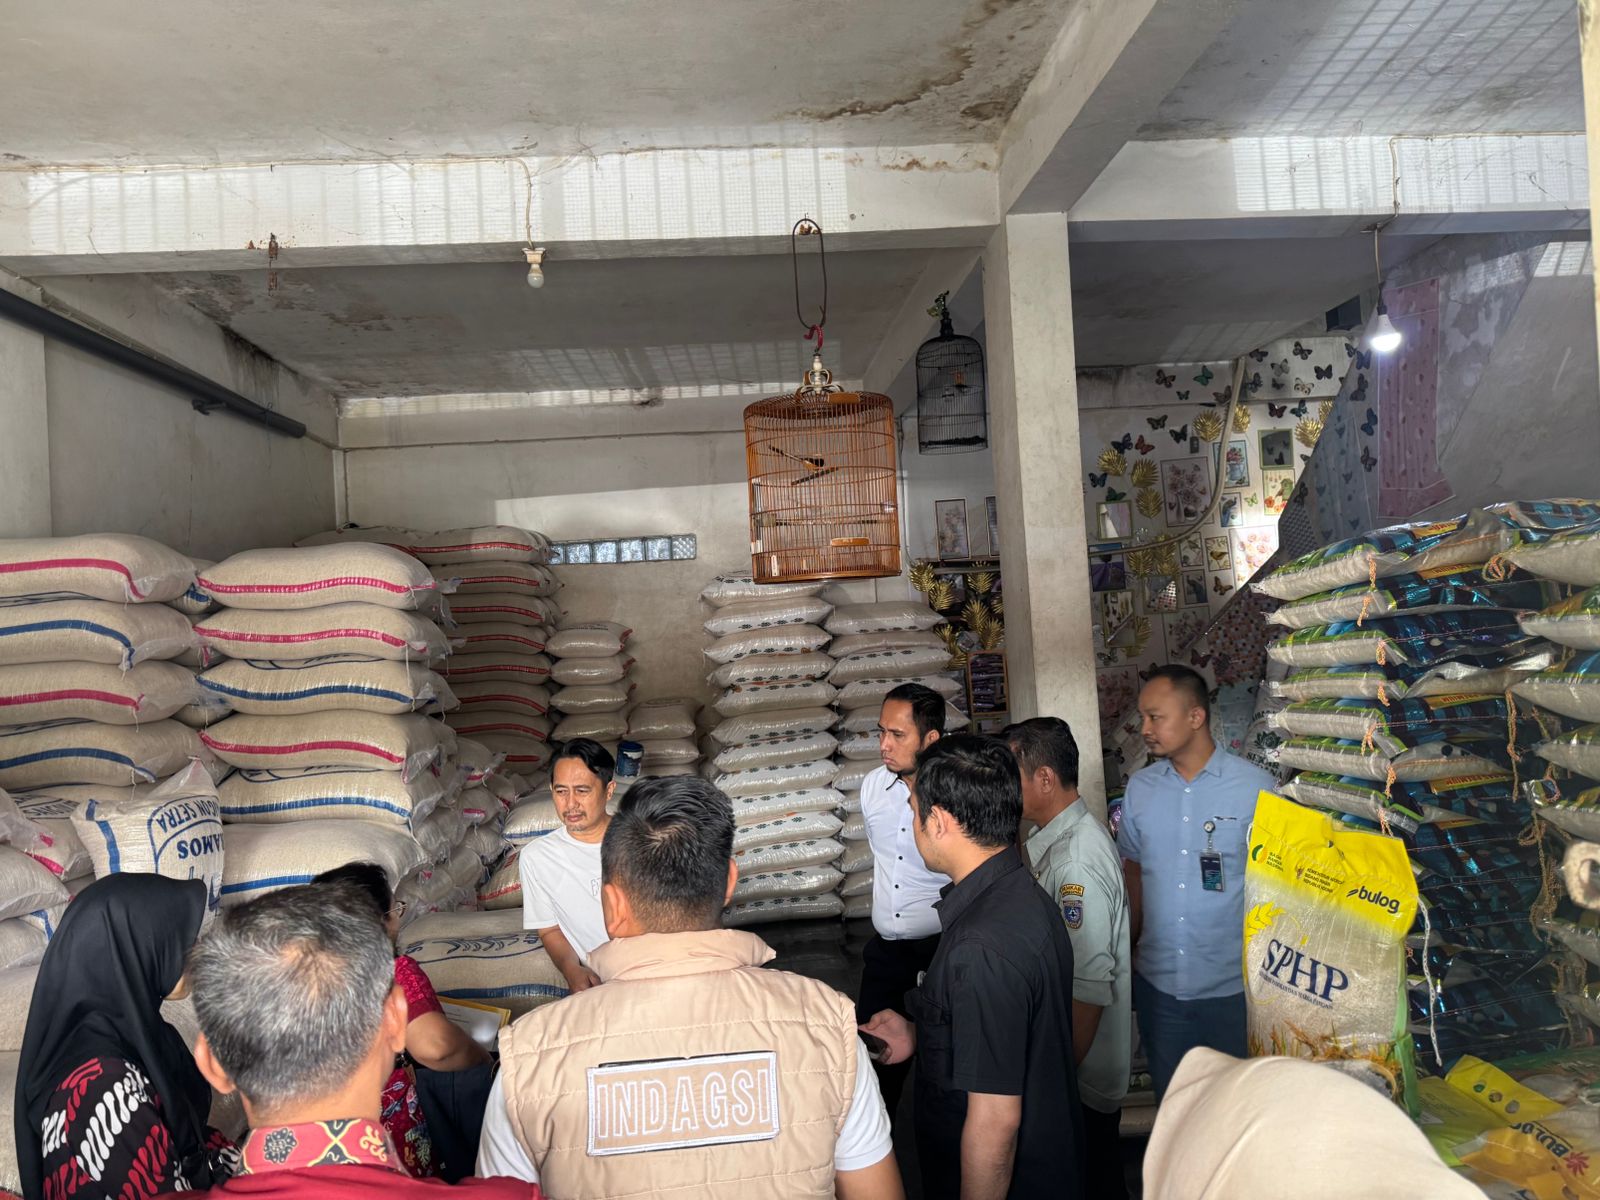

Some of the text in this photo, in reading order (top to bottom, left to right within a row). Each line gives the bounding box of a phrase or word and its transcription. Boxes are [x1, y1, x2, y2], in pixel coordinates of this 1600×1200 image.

[156, 802, 198, 833] SETRA
[1358, 885, 1400, 914] bulog
[1261, 938, 1349, 1003] SPHP
[596, 1068, 771, 1139] INDAGSI
